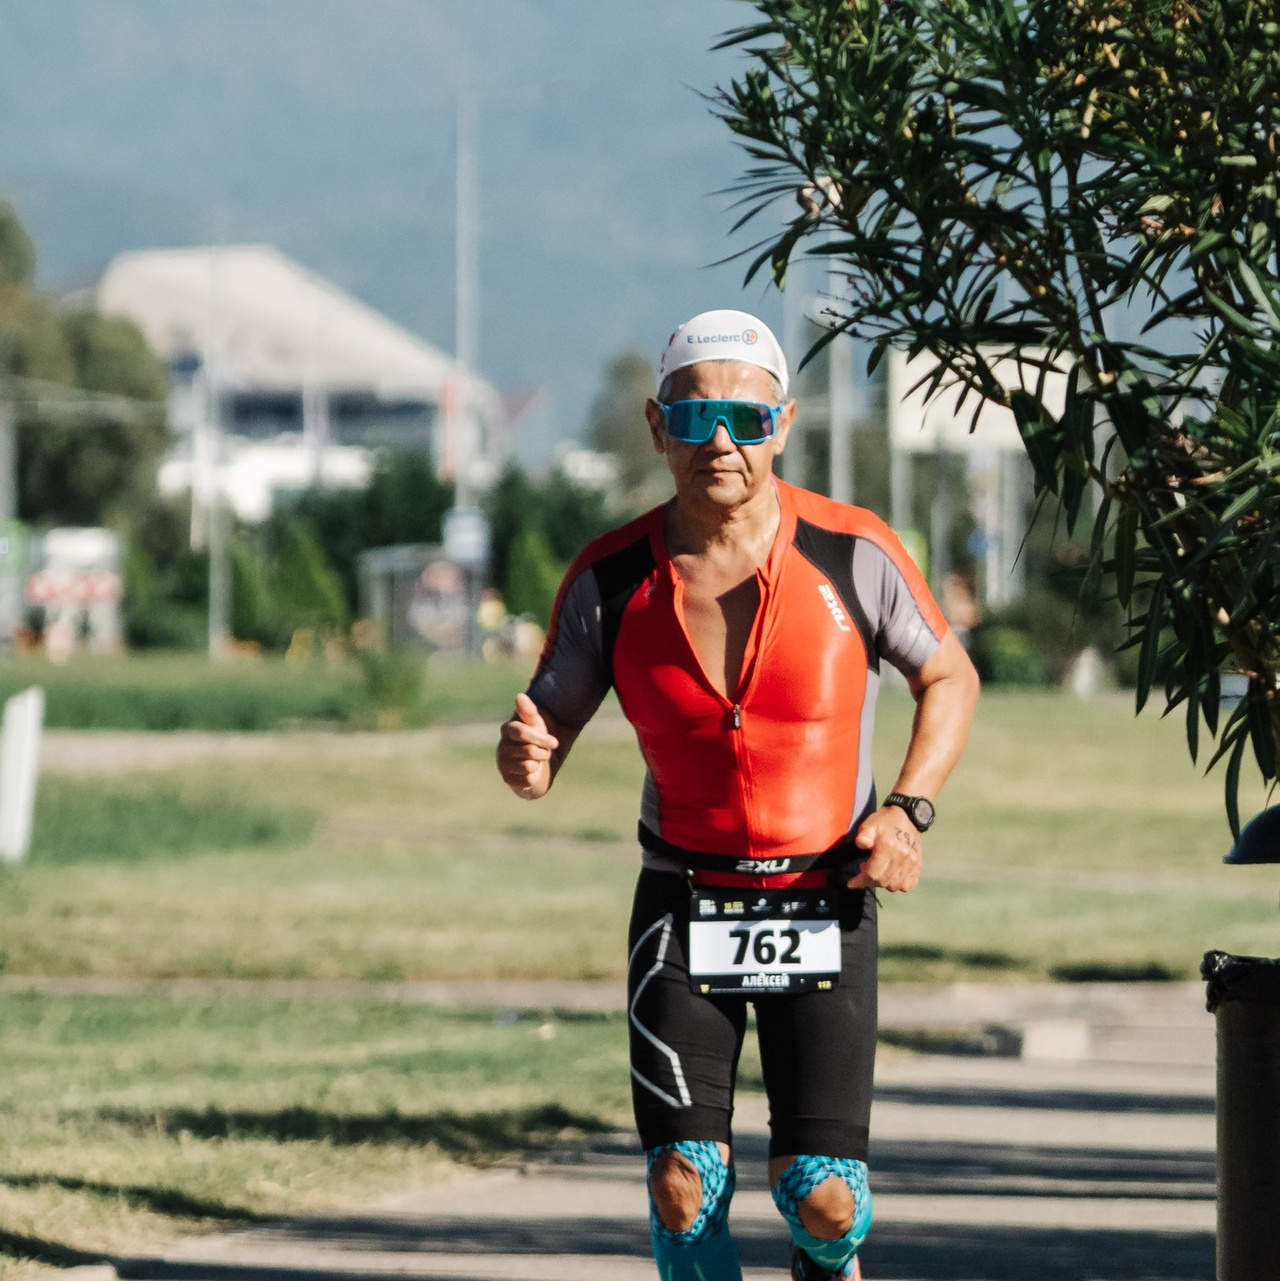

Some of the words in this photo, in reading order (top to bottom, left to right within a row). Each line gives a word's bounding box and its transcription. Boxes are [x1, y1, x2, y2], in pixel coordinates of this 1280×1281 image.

[736, 858, 791, 873] 2XU
[729, 928, 801, 965] 762
[742, 972, 790, 988] АЛЕКСЕЙ
